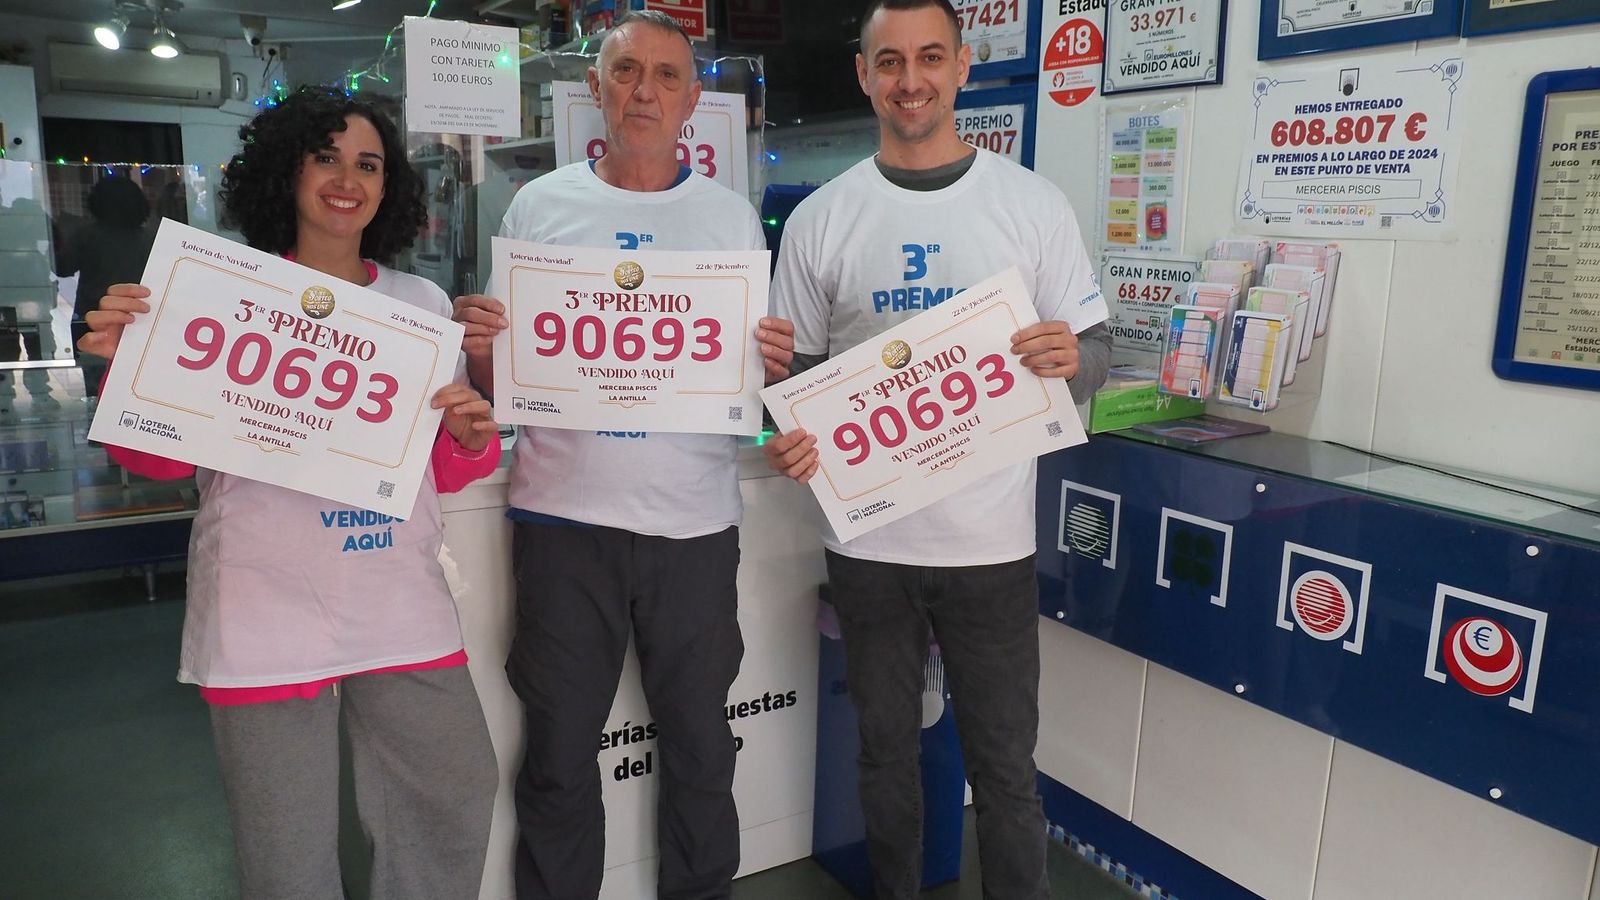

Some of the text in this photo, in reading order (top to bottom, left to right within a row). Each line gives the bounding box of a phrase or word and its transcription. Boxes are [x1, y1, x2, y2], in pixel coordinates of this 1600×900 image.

[1130, 6, 1196, 32] 33.971 €
[430, 38, 500, 53] PAGO MINIMO
[1056, 25, 1091, 56] +18
[431, 56, 495, 68] CON TARJETA
[1120, 52, 1201, 76] VENDIDO AQUÍ
[1154, 50, 1193, 60] EUROMILLONES
[432, 72, 493, 85] 10,00 EUROS
[1295, 98, 1403, 114] HEMOS ENTREGADO
[965, 114, 1013, 130] PREMIO
[1129, 115, 1160, 128] BOTES
[1271, 112, 1427, 147] 608.807 €
[1256, 148, 1438, 163] EN PREMIOS A LO LARGO DE 2024
[1275, 163, 1410, 175] EN ESTE PUNTO DE VENTA
[1296, 185, 1381, 195] MERCERIA PISCIS
[214, 252, 225, 260] de
[226, 255, 262, 272] Navidad
[1110, 266, 1191, 282] GRAN PREMIO
[872, 287, 968, 313] PREMI
[1118, 282, 1172, 302] 68.457
[592, 292, 692, 313] PREMIO
[952, 309, 960, 317] 22
[969, 288, 1003, 309] Diciembre
[390, 312, 400, 321] 22
[408, 319, 444, 336] Diciembre
[1108, 326, 1152, 340] VENDIDO
[268, 310, 377, 361] PREMIO
[533, 311, 722, 362] 90693
[176, 317, 399, 423] 90693
[577, 366, 675, 381] VENDIDO AQUÍ
[815, 367, 842, 385] Navidad
[873, 345, 967, 399] PREMIO
[222, 390, 333, 432] VENDIDO AQUÍ
[833, 354, 1015, 466] 90693
[139, 425, 183, 442] NACIONAL
[141, 418, 176, 433] LOTERÍA
[240, 416, 308, 440] MERCERIA PISCIS
[259, 435, 291, 448] ANTILLA
[892, 413, 981, 464] VENDIDO AQUÍ
[917, 437, 971, 466] MERCERIA PISCIS
[940, 451, 966, 467] ANTILLA
[862, 499, 887, 512] LOTERÍA
[864, 501, 896, 518] NACIONAL
[320, 510, 406, 528] VENDID
[342, 526, 393, 551] AQUÍ
[724, 689, 797, 721] uestas
[600, 721, 658, 750] erías
[614, 752, 652, 782] del
